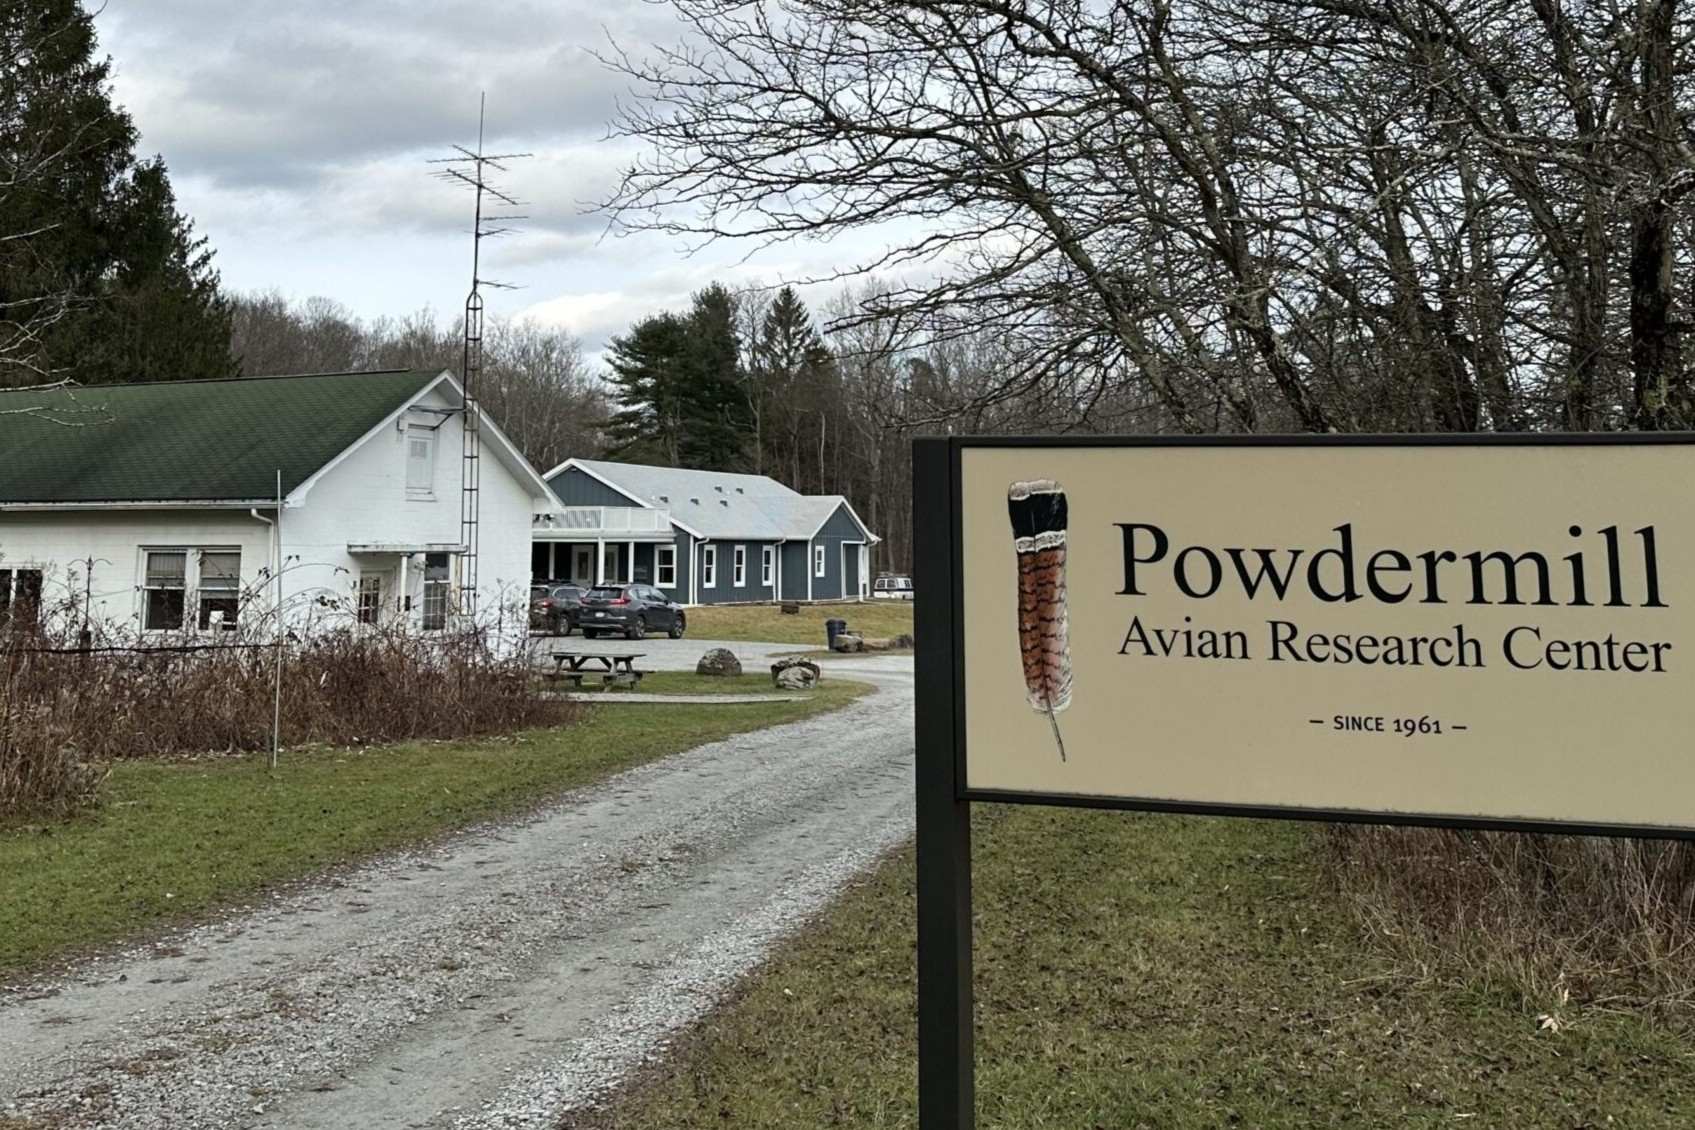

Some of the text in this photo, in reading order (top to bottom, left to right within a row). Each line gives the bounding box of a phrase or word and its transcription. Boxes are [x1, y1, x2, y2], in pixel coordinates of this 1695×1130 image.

[1111, 522, 1670, 608] Powdermill
[1116, 615, 1673, 673] Avian Research Center
[1333, 714, 1443, 738] SINCE 1961
